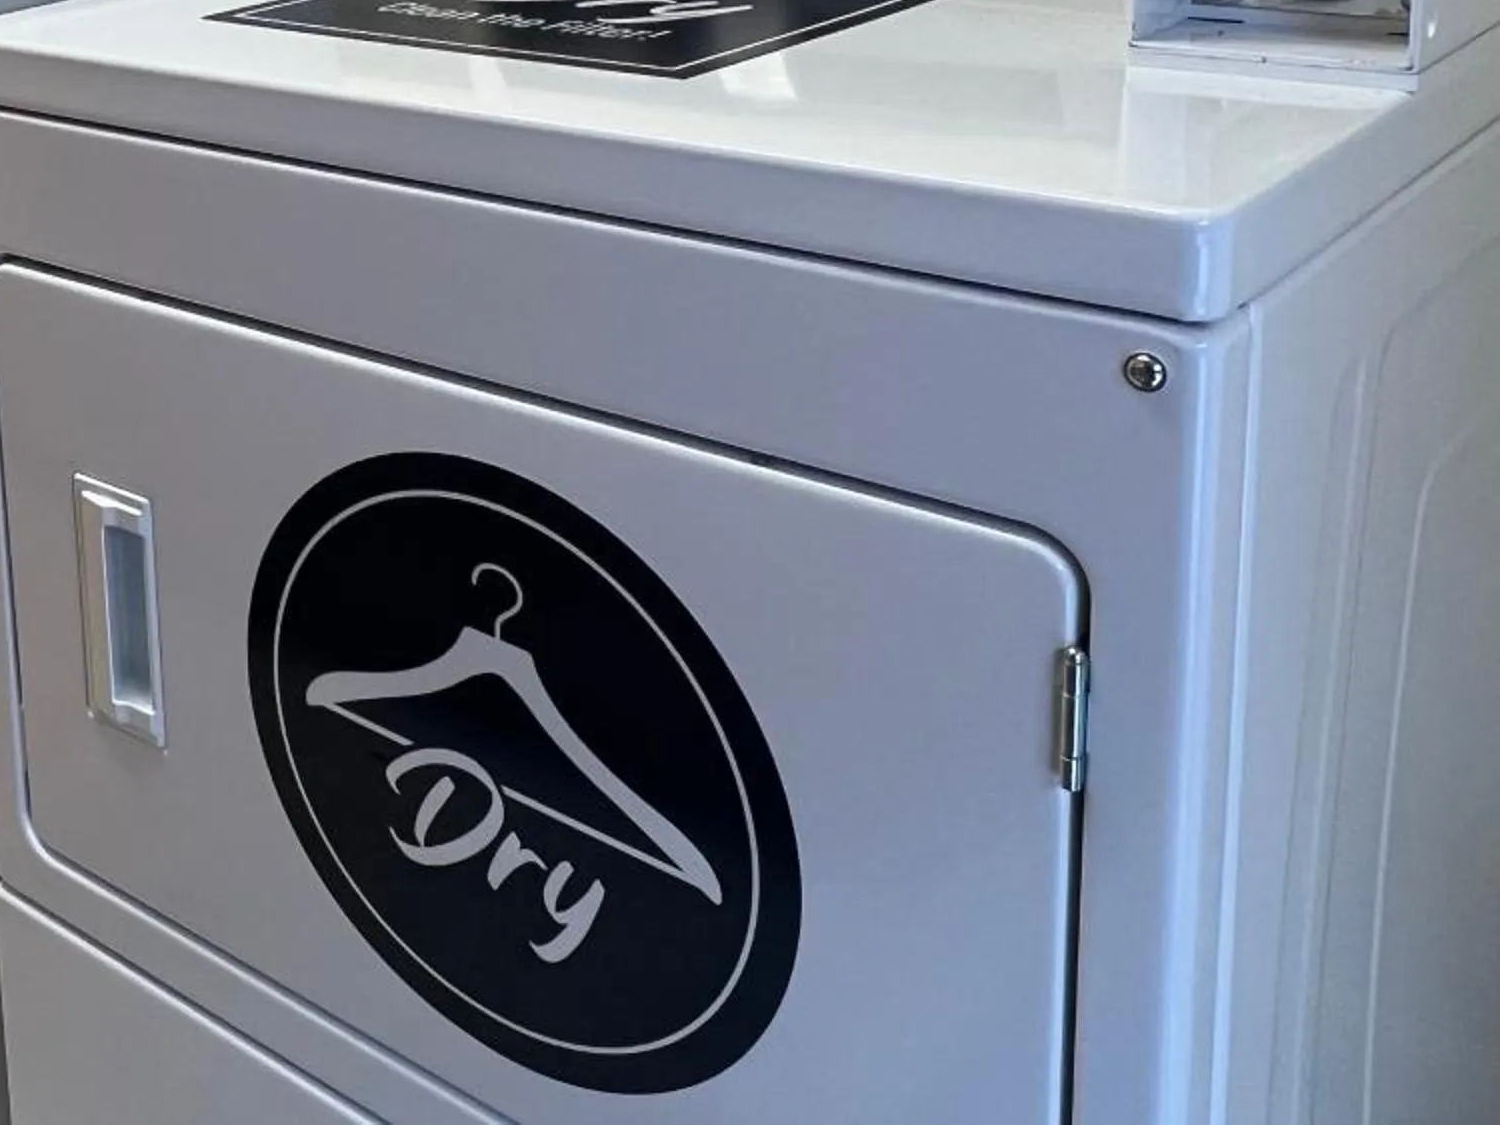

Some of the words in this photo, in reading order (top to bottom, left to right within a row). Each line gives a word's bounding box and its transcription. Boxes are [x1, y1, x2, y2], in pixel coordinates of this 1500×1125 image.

[377, 1, 480, 21] Clean
[476, 12, 546, 29] the
[540, 18, 673, 41] Filter!
[385, 747, 605, 963] Dry
